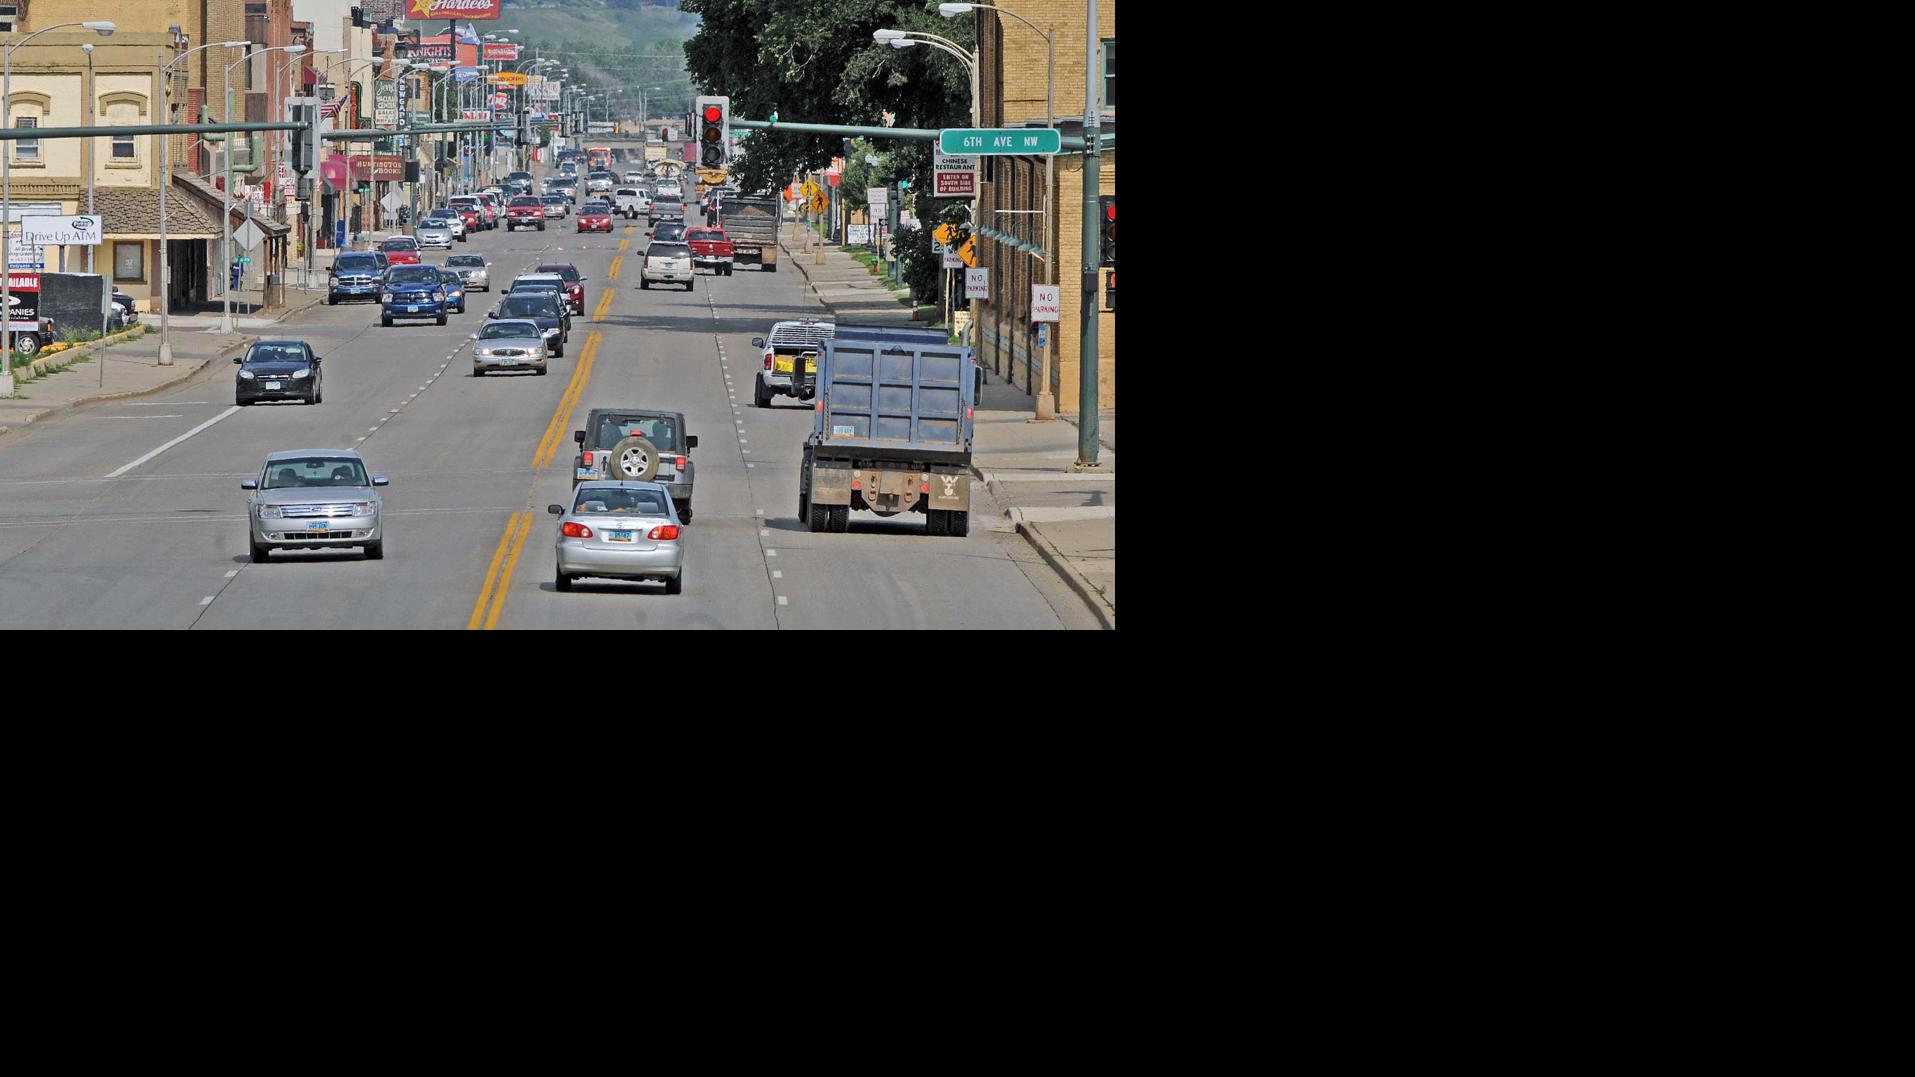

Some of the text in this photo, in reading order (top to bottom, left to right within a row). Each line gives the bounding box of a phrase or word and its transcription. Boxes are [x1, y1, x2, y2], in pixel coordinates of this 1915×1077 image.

[963, 137, 1038, 147] 6TH AVE NW
[25, 231, 53, 241] Drive
[55, 231, 70, 243] Up
[73, 231, 96, 241] ATM
[8, 277, 38, 288] AILABLE
[1039, 293, 1053, 301] NO
[9, 308, 35, 316] ANIES
